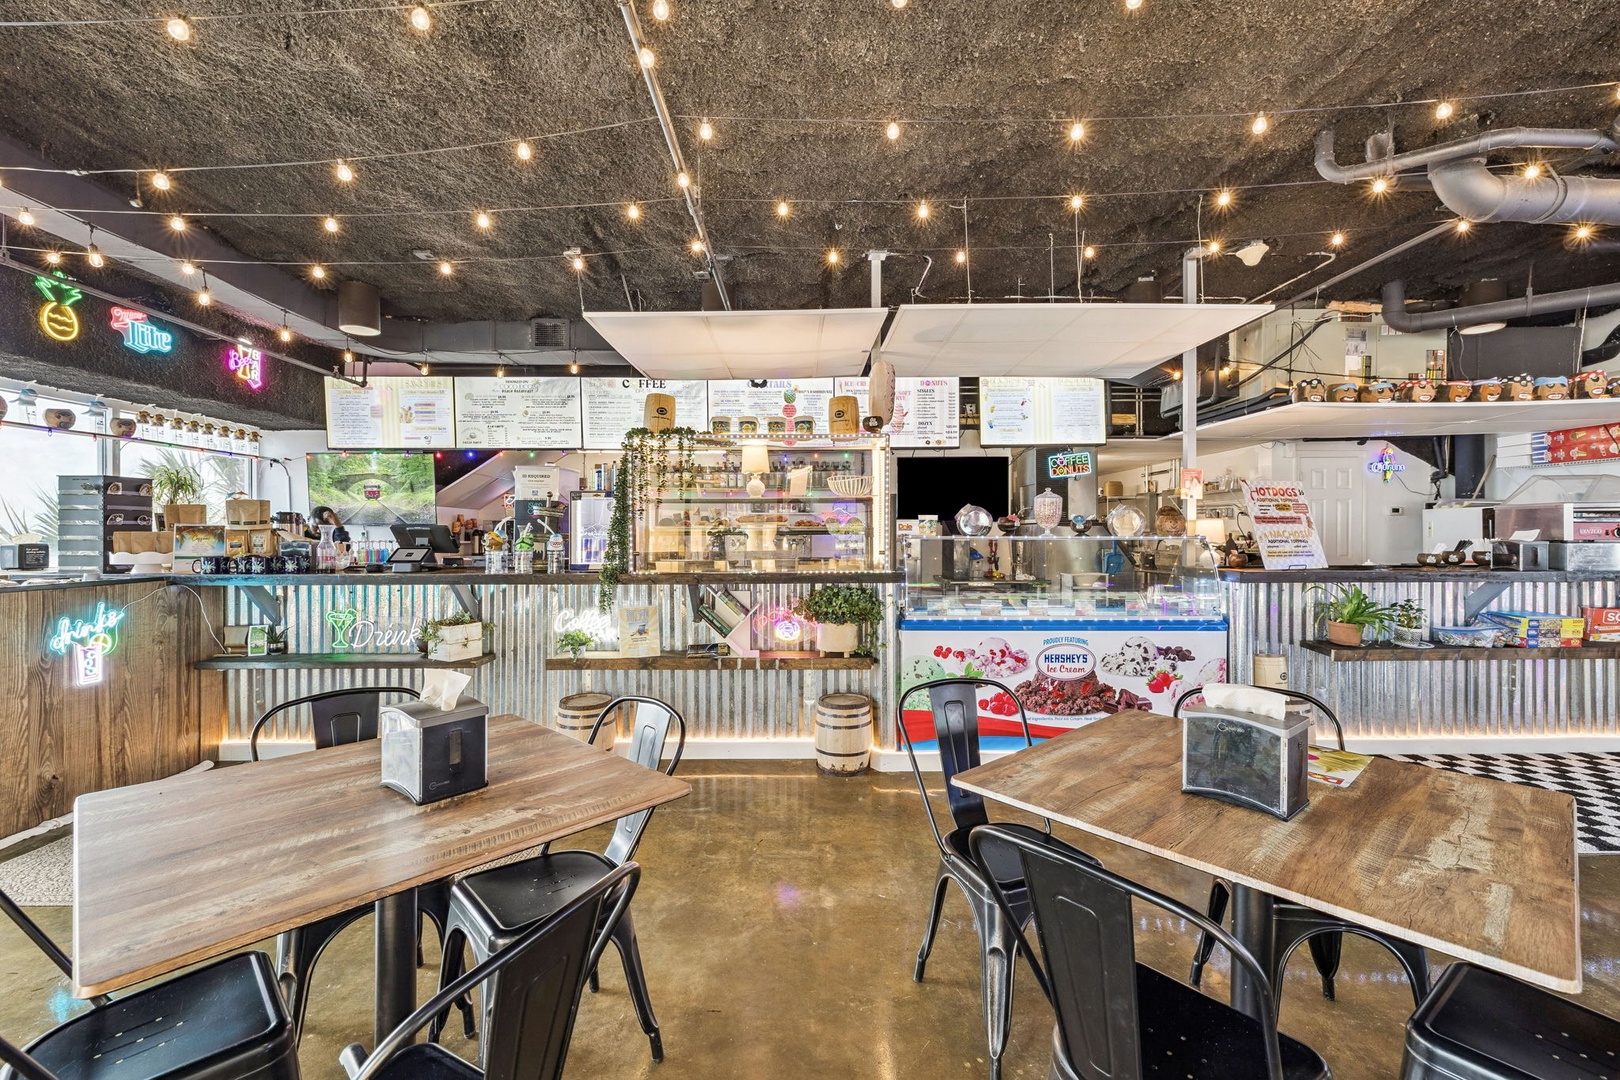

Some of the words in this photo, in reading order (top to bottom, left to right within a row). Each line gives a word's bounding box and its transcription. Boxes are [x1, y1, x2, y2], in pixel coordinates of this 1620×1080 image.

[127, 320, 172, 354] Lite
[229, 349, 254, 370] Beer
[251, 350, 260, 381] BAR
[622, 379, 667, 389] CFFEE
[1050, 454, 1089, 468] COFFEE
[1051, 464, 1090, 477] DONUTS
[1250, 486, 1298, 497] HOTDOGS
[554, 608, 611, 632] Coffee
[52, 601, 125, 654] drinks
[1043, 637, 1064, 646] PROUDLY
[1064, 637, 1089, 646] FEATURING
[1044, 654, 1088, 663] HERSHEY'S
[1046, 664, 1058, 673] Ice
[1060, 665, 1086, 673] Cream
